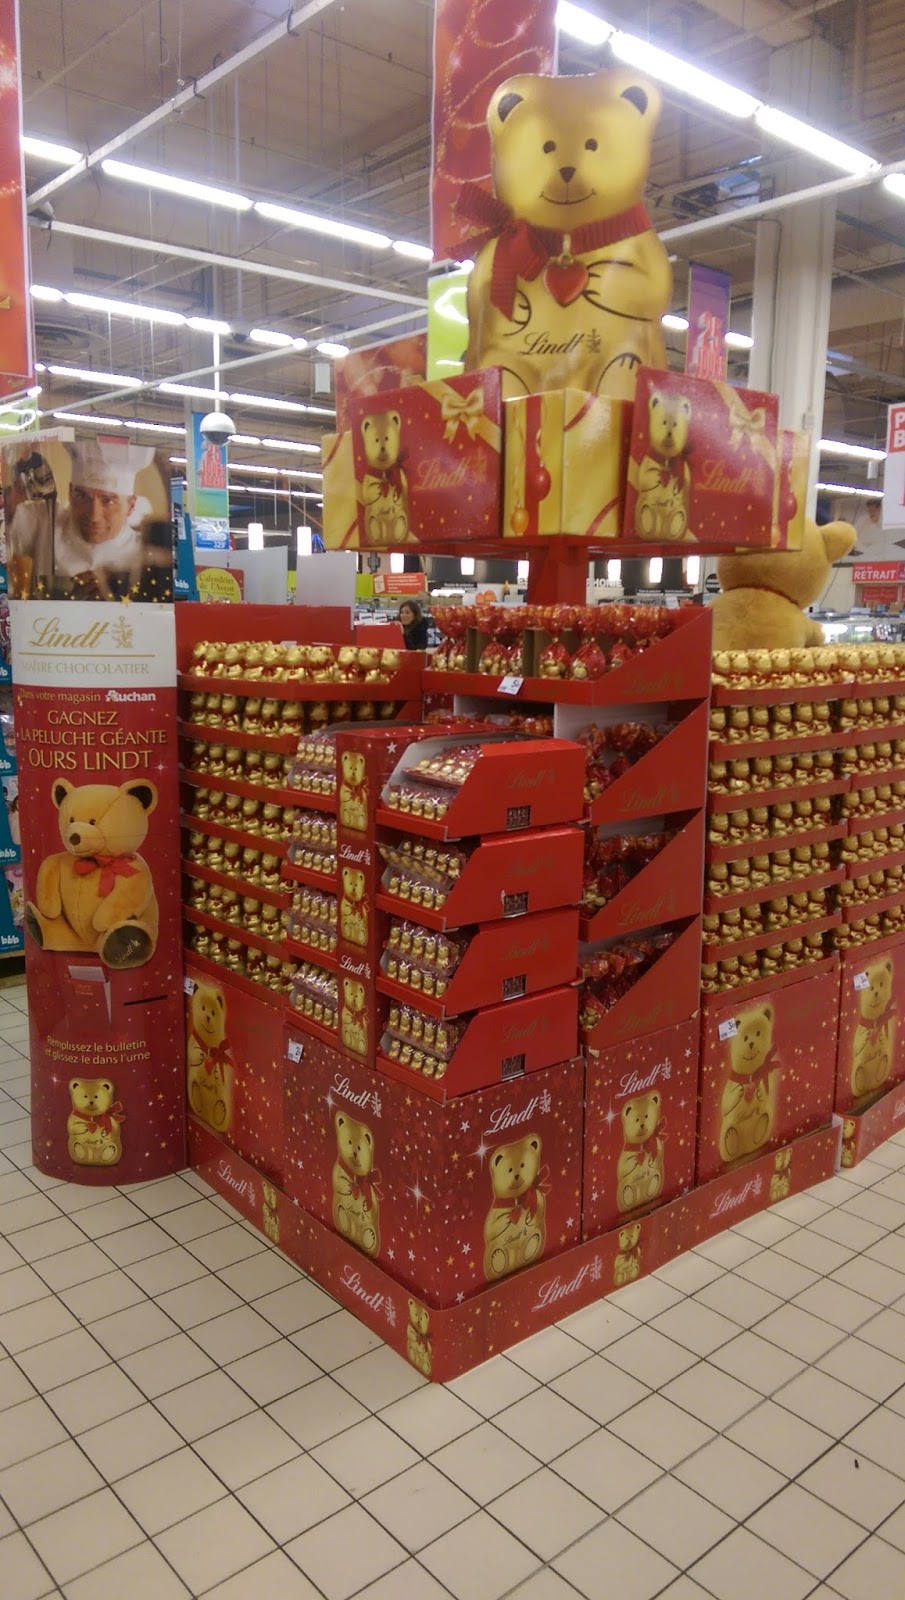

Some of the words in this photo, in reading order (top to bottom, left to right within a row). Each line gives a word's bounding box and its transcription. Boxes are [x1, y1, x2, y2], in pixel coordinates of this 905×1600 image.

[520, 330, 584, 355] Lindt
[413, 457, 472, 491] Lindt
[694, 460, 749, 493] Lindt
[199, 575, 235, 584] Calendrier
[854, 570, 896, 580] RETRAIT
[29, 617, 110, 648] Lindt
[22, 660, 53, 674] MAÎTRE
[56, 662, 149, 675] CHOCOLATIER
[20, 688, 34, 699] Dans
[36, 691, 56, 701] votre
[58, 692, 101, 704] magasin
[106, 690, 157, 702] Auchan
[48, 710, 118, 726] GAGNEZ
[21, 730, 31, 741] LA
[33, 730, 96, 746] PELUCHE
[101, 728, 167, 746] GÉANTE
[29, 748, 78, 770] OURS
[84, 750, 153, 770] LINDT
[338, 844, 365, 864] Lindt
[339, 954, 365, 976] Lindt
[47, 1035, 92, 1053] Remplissez
[94, 1043, 103, 1052] le
[106, 1039, 146, 1052] bulletin
[93, 1055, 118, 1065] dans
[120, 1052, 151, 1063] l'urne
[330, 1073, 371, 1110] Lindt
[615, 1066, 662, 1099] Lindt
[484, 1098, 538, 1136] Lindt
[216, 1159, 249, 1197] Lindt
[709, 1185, 754, 1219] Lindt
[339, 1264, 386, 1312] Lindt
[531, 1264, 589, 1312] Lindt
